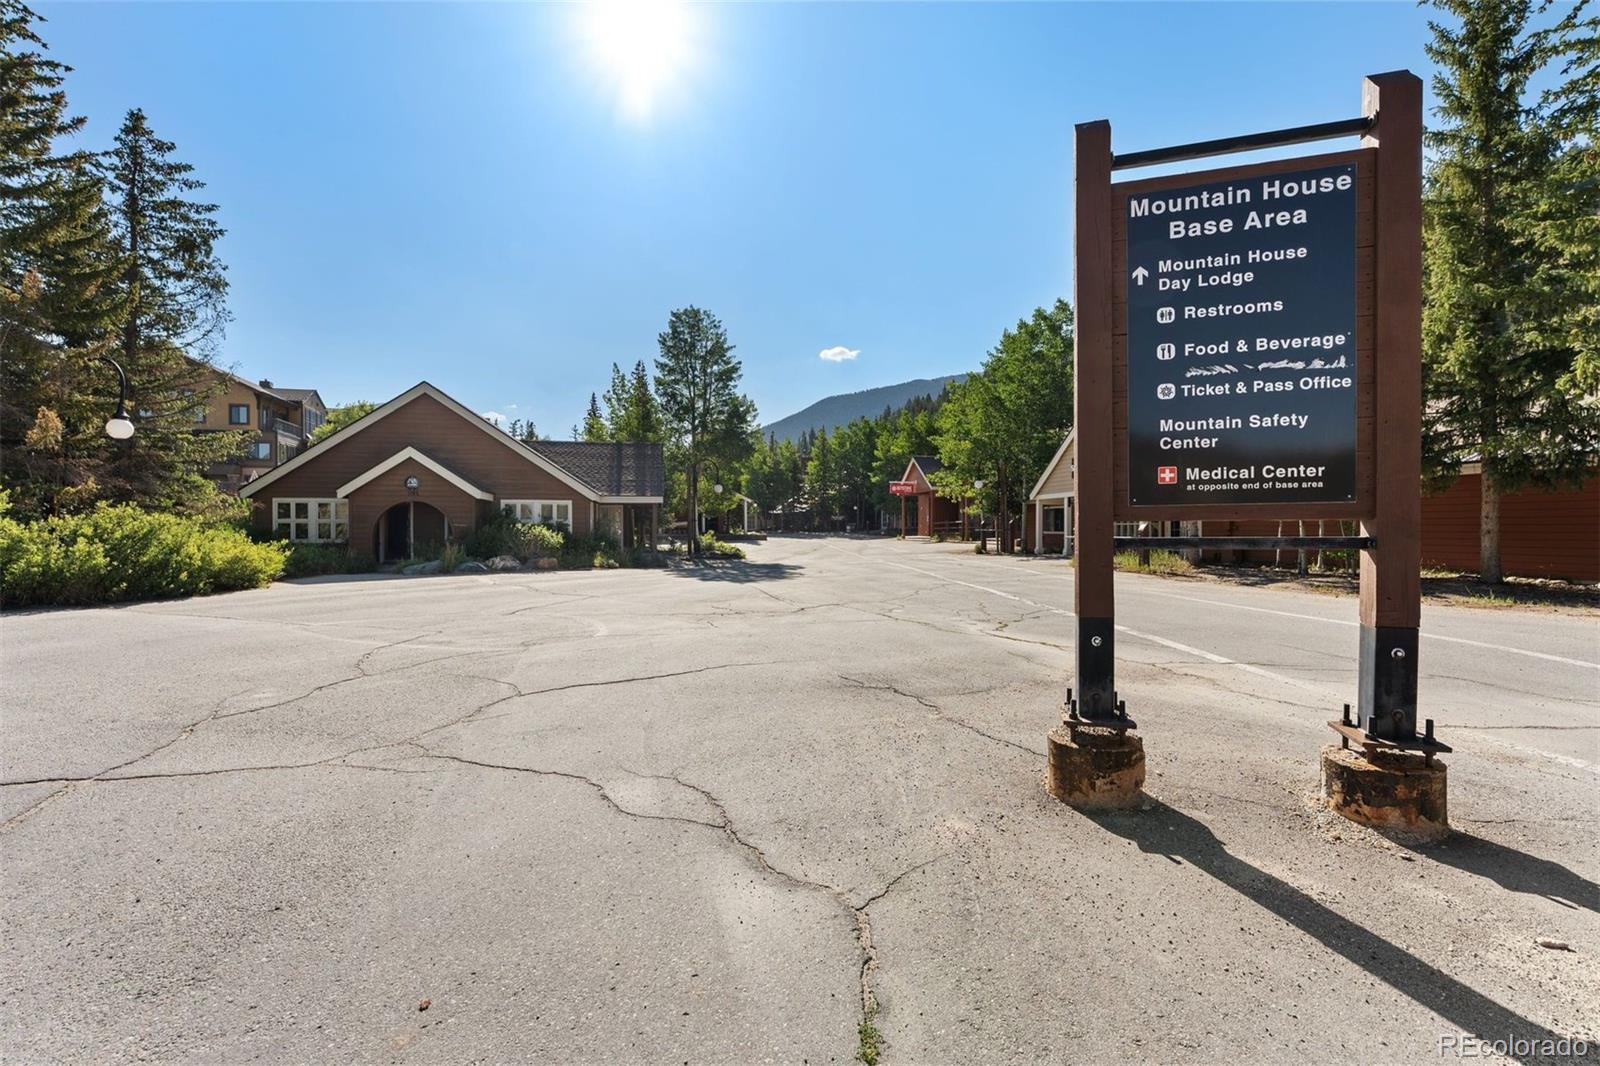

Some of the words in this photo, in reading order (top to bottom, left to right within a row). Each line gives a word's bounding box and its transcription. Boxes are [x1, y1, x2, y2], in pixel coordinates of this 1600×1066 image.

[1131, 186, 1251, 217] Mountain
[1263, 174, 1352, 200] House
[1170, 218, 1233, 239] Base
[1244, 209, 1307, 230] Area
[1159, 253, 1241, 273] Mountain
[1249, 247, 1307, 264] House
[1159, 276, 1191, 292] Day
[1199, 271, 1254, 287] Lodge
[1185, 301, 1283, 319] Restrooms
[1185, 340, 1229, 356] Food
[1236, 339, 1249, 353] &
[1256, 334, 1346, 351] Beverage
[1181, 383, 1230, 397] Ticket
[1236, 381, 1247, 394] &
[1254, 380, 1294, 393] Pass
[1300, 376, 1352, 391] Office
[1160, 415, 1242, 432] Mountain
[1249, 413, 1309, 429] Safety
[1160, 436, 1218, 449] Center
[1187, 466, 1255, 480] Medical
[1262, 464, 1326, 479] Center
[1198, 481, 1240, 492] opposite
[1242, 482, 1260, 490] end
[1263, 481, 1273, 490] of
[1276, 481, 1299, 489] base
[1302, 481, 1324, 489] area
